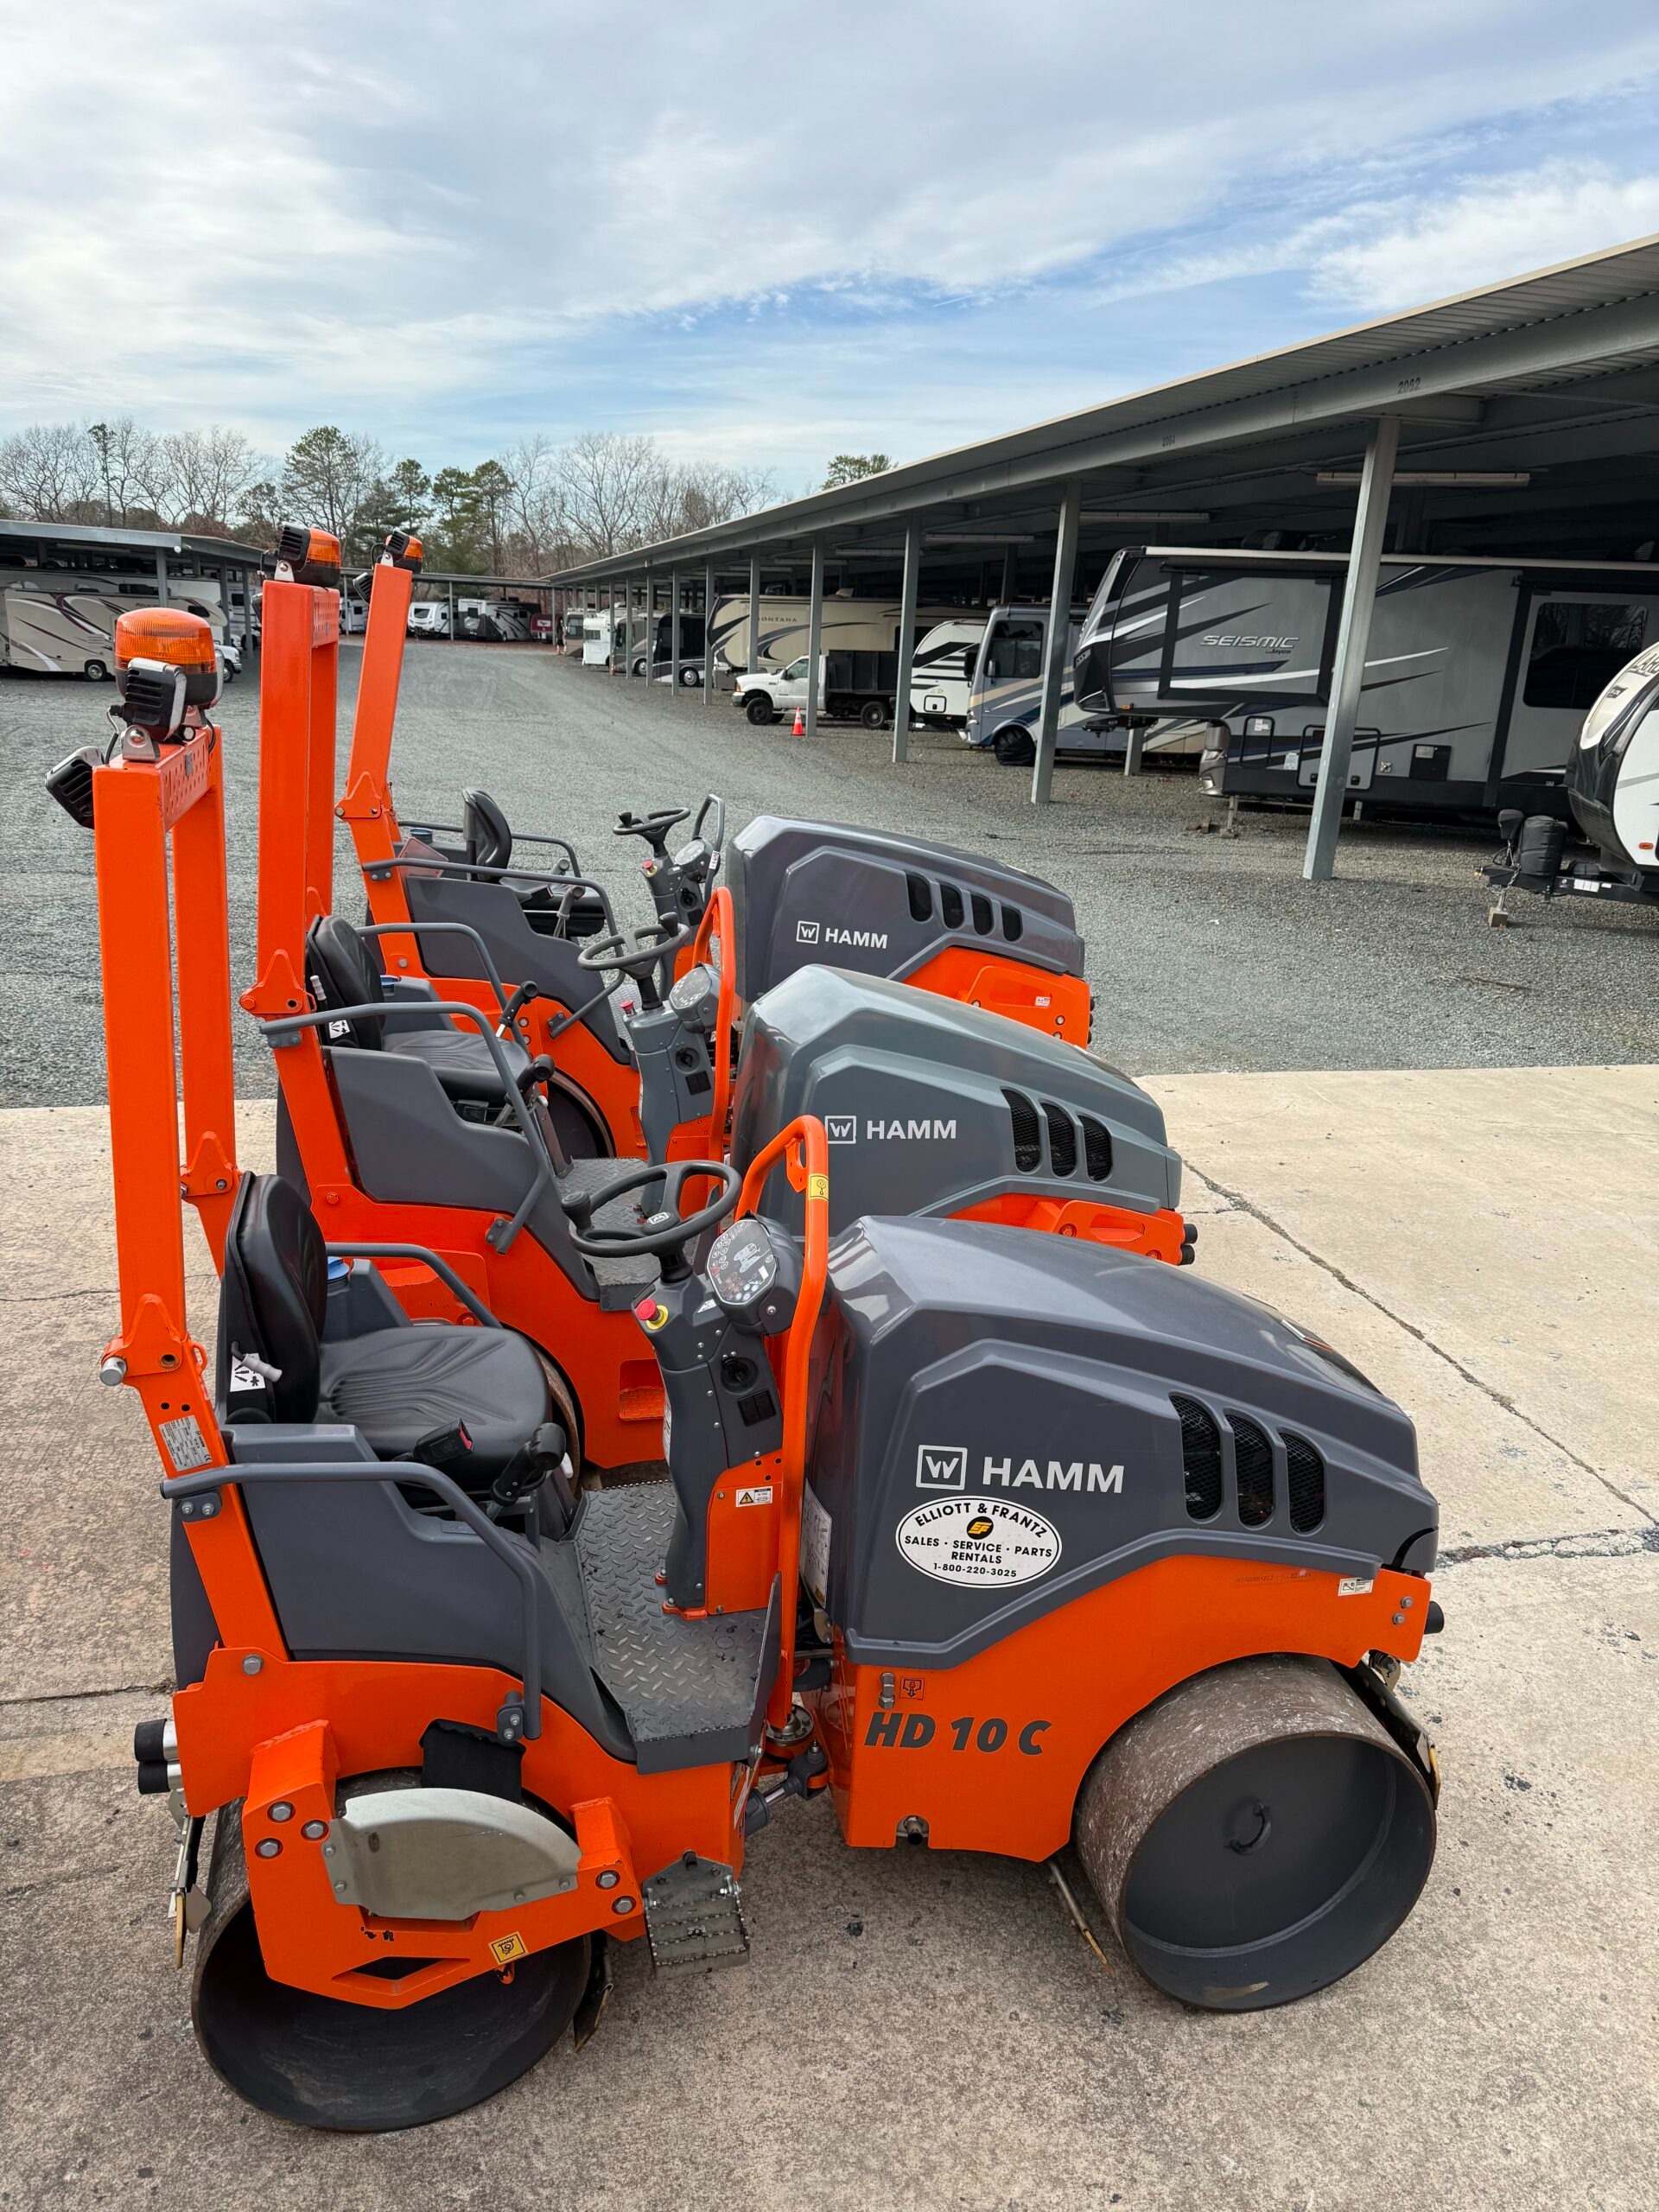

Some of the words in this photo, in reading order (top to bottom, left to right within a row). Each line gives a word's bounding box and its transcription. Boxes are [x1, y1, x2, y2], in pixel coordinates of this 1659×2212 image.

[1200, 635, 1300, 648] SEISMIC
[825, 927, 888, 950] HAMM
[867, 1120, 957, 1140] HAMM
[982, 1456, 1125, 1494] HAMM
[914, 1503, 971, 1527] ELLIOTT
[977, 1503, 988, 1514] &
[992, 1504, 1048, 1538] FRANTZ
[905, 1535, 940, 1547] SALES
[953, 1540, 1002, 1553] SERVICE
[1014, 1546, 1052, 1557] PARTS
[951, 1551, 1002, 1564] RENTALS
[933, 1563, 1017, 1577] 1-800-220-3025
[864, 1712, 936, 1749] HD
[950, 1717, 1008, 1753] 10
[1019, 1719, 1052, 1756] C
